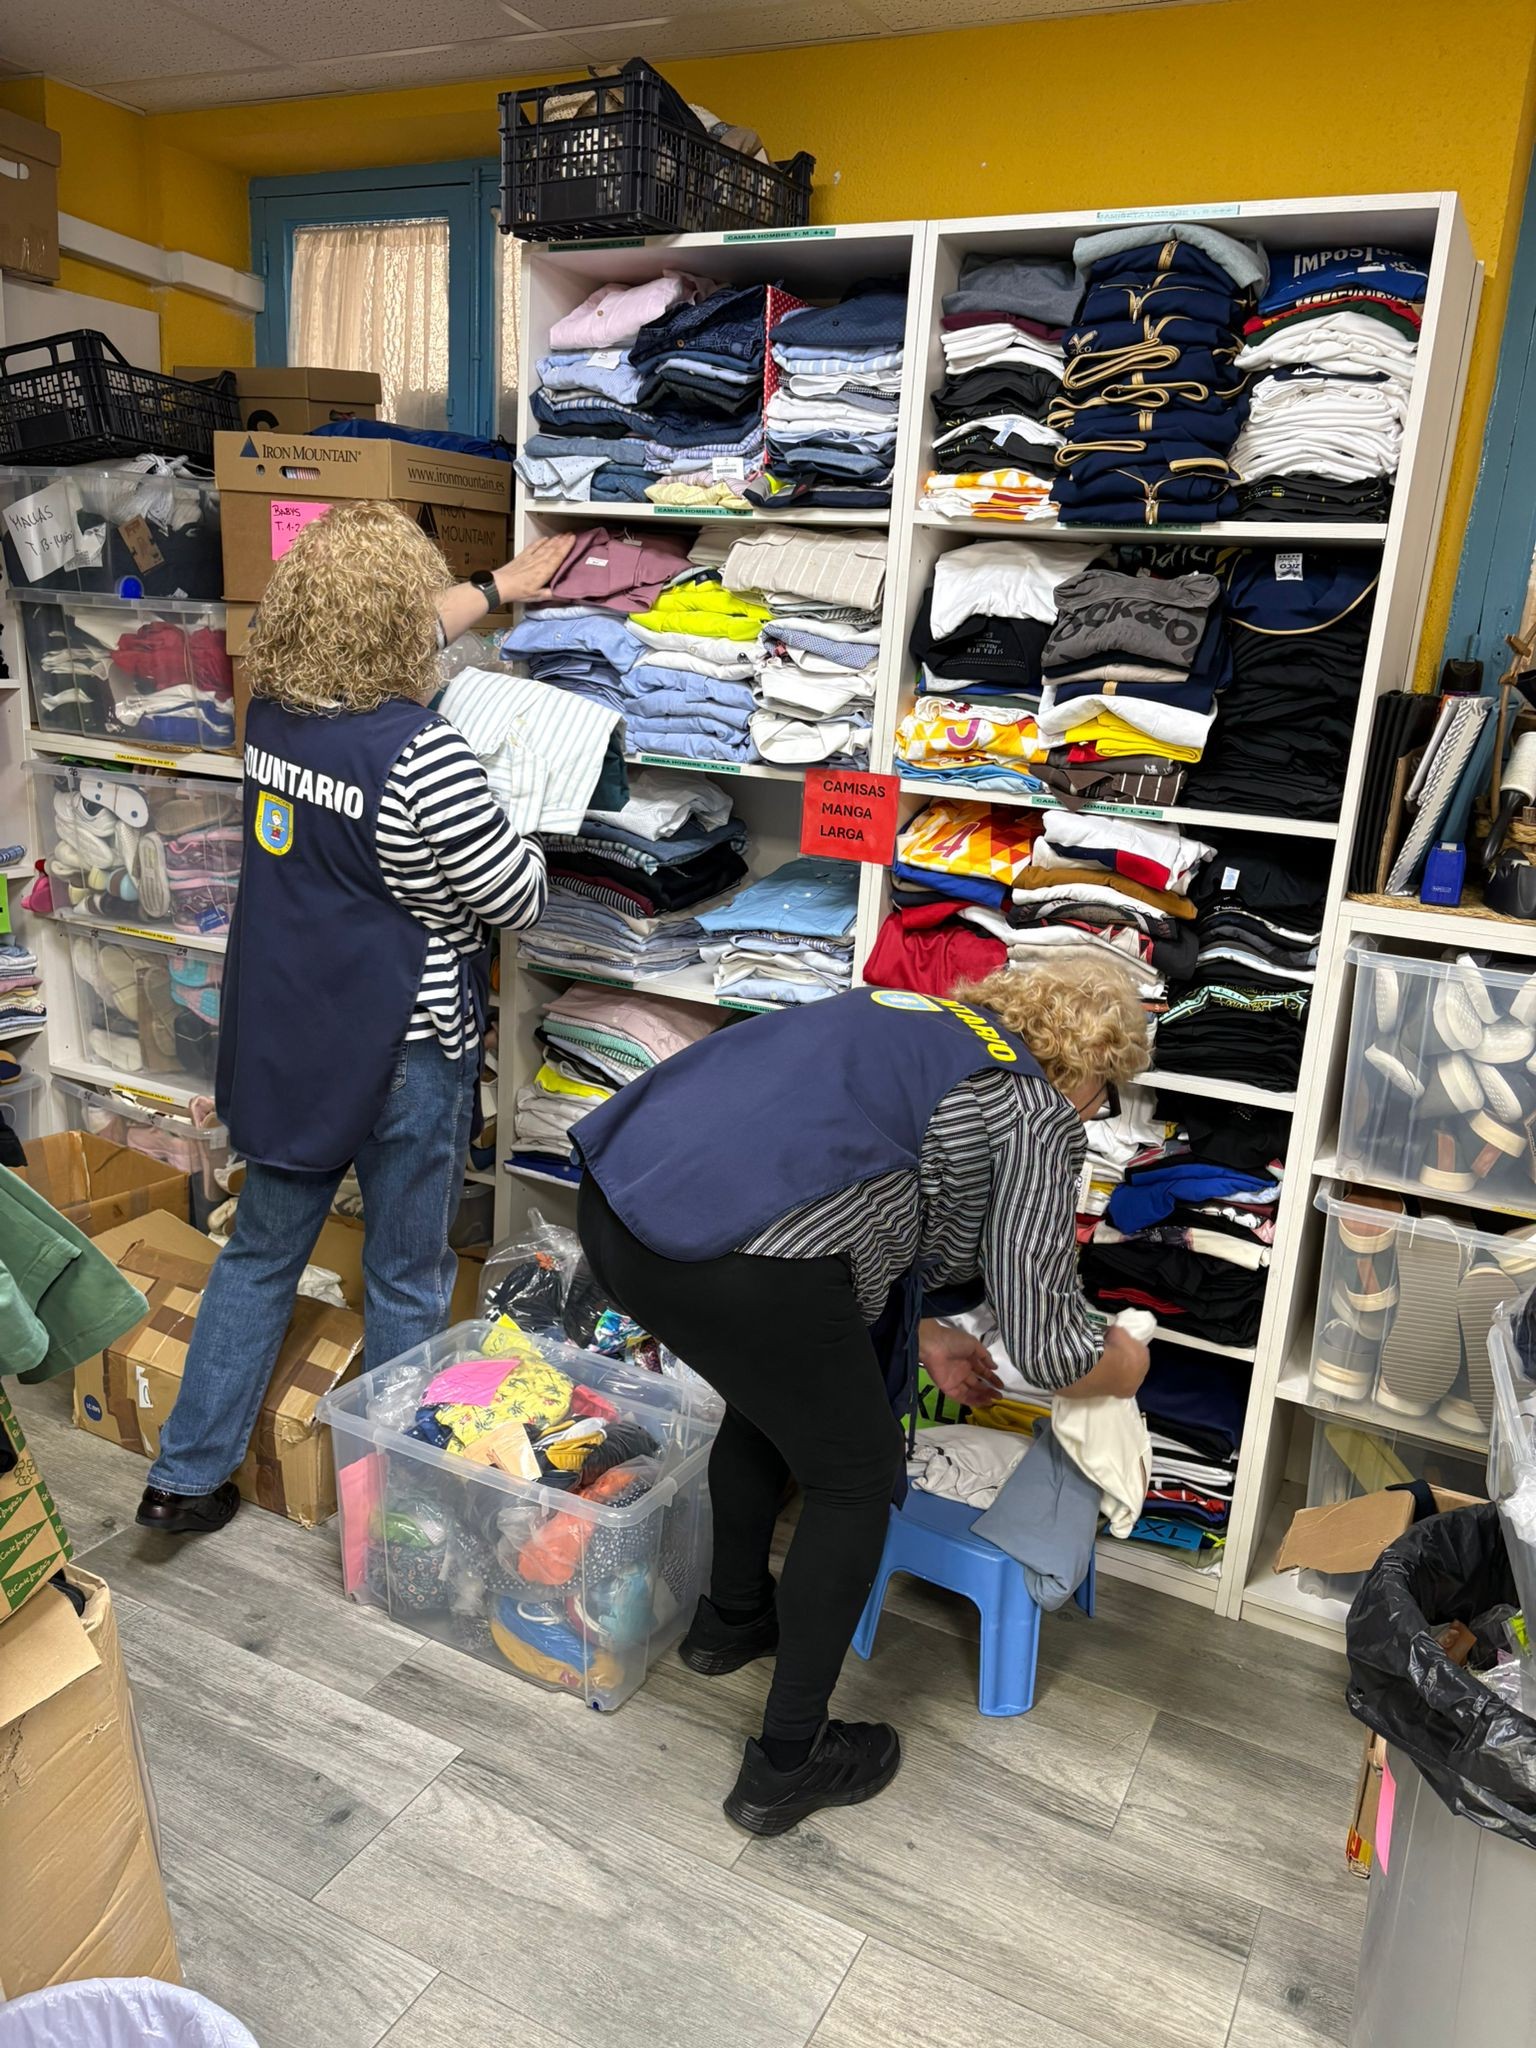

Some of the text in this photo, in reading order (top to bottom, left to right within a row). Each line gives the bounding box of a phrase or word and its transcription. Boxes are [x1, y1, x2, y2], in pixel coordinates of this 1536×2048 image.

[262, 444, 291, 460] IRON
[407, 466, 505, 492] www.ironmountain.es
[244, 742, 364, 820] OLUNTARIO
[823, 780, 886, 798] CAMISAS
[821, 802, 872, 820] MANGA
[820, 824, 865, 842] LARGA
[931, 822, 981, 858] 4
[1131, 1520, 1192, 1544] XL
